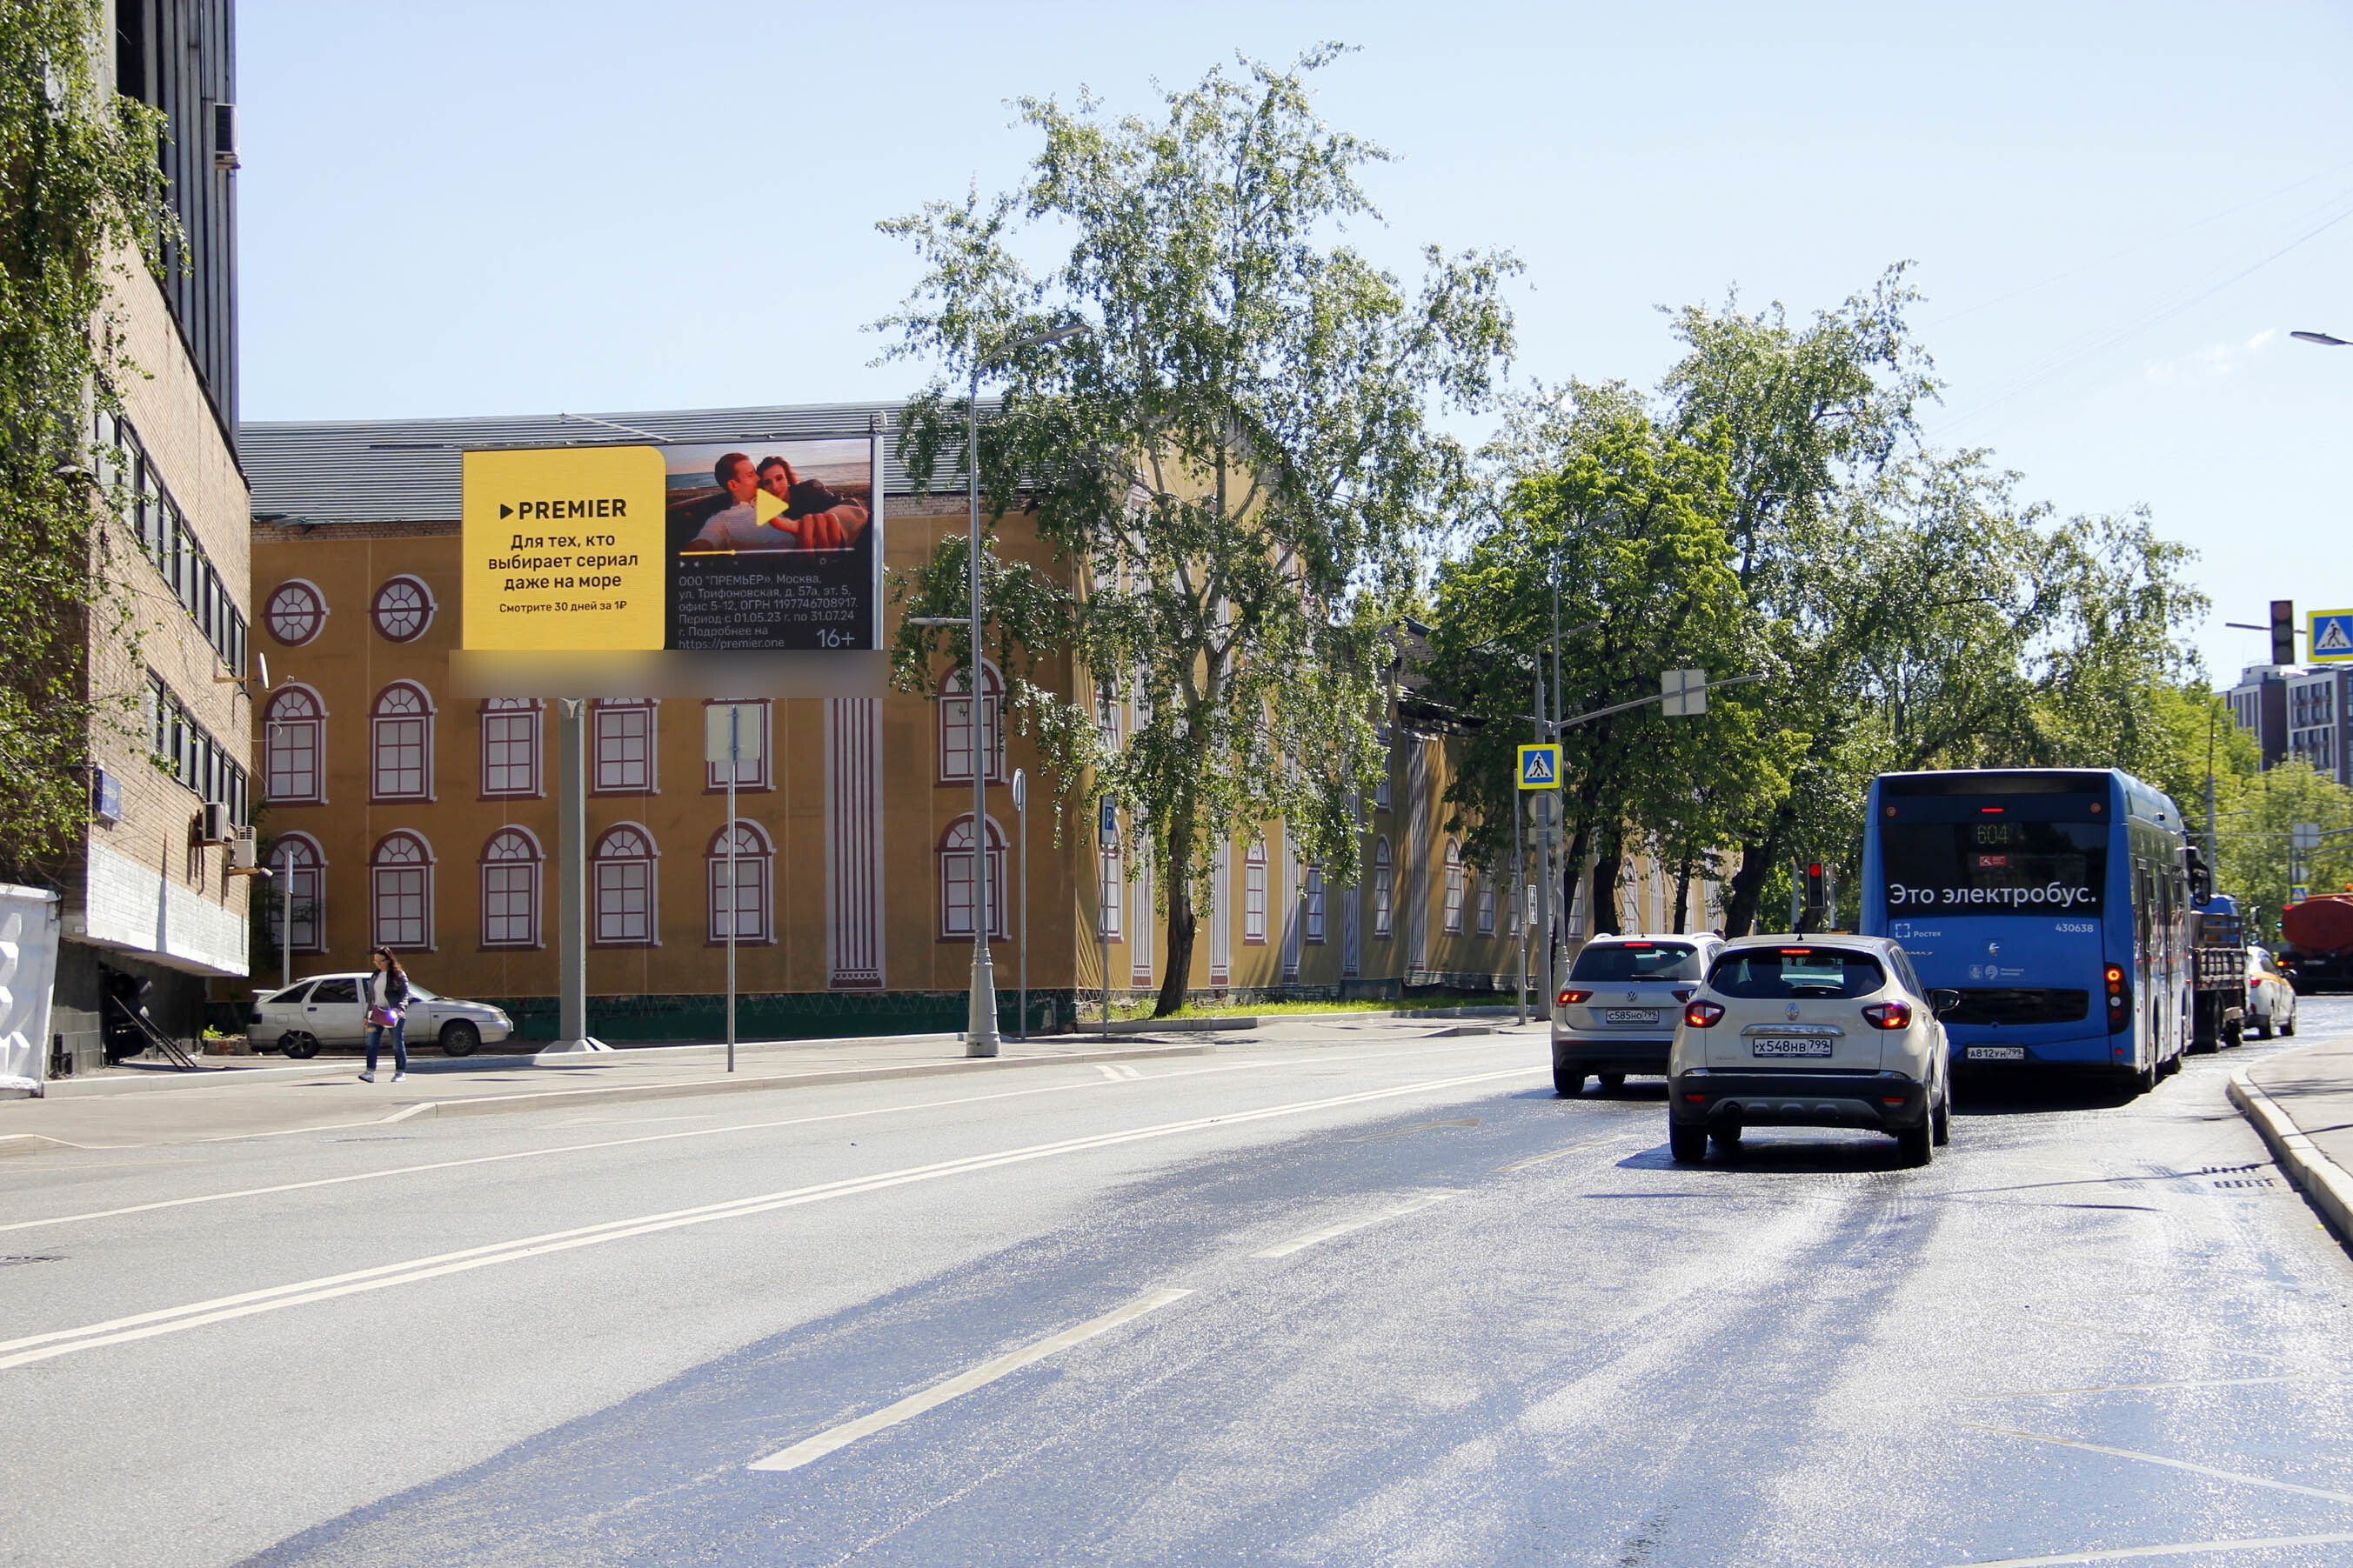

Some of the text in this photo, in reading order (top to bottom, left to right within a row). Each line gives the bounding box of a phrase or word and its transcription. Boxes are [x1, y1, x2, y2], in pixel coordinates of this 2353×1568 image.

[519, 498, 627, 520] PREMIER
[511, 535, 615, 550] Для тех, кто
[489, 554, 638, 571] выбирает сериал
[504, 576, 622, 591] даже на море
[776, 573, 822, 584] Москва,
[678, 590, 695, 600] ул.
[499, 603, 552, 614] Смотрите
[554, 602, 568, 611] 30
[571, 601, 598, 612] дней
[599, 602, 612, 611] за
[678, 602, 708, 613] офис
[740, 598, 770, 611] ОГРН
[678, 613, 722, 625] Период
[733, 611, 781, 624] 01.05.23
[793, 612, 808, 622] по
[811, 610, 855, 622] 31.07.24
[688, 625, 752, 638] Подробнее
[754, 626, 769, 635] на
[816, 628, 855, 648] 16+
[678, 637, 785, 651] https://premier.one
[1977, 824, 2009, 844] 604
[1889, 881, 2097, 908] Это электробус.
[1914, 930, 1942, 939] Ростех
[2055, 924, 2094, 933] 430638
[1808, 1039, 1828, 1049] 799
